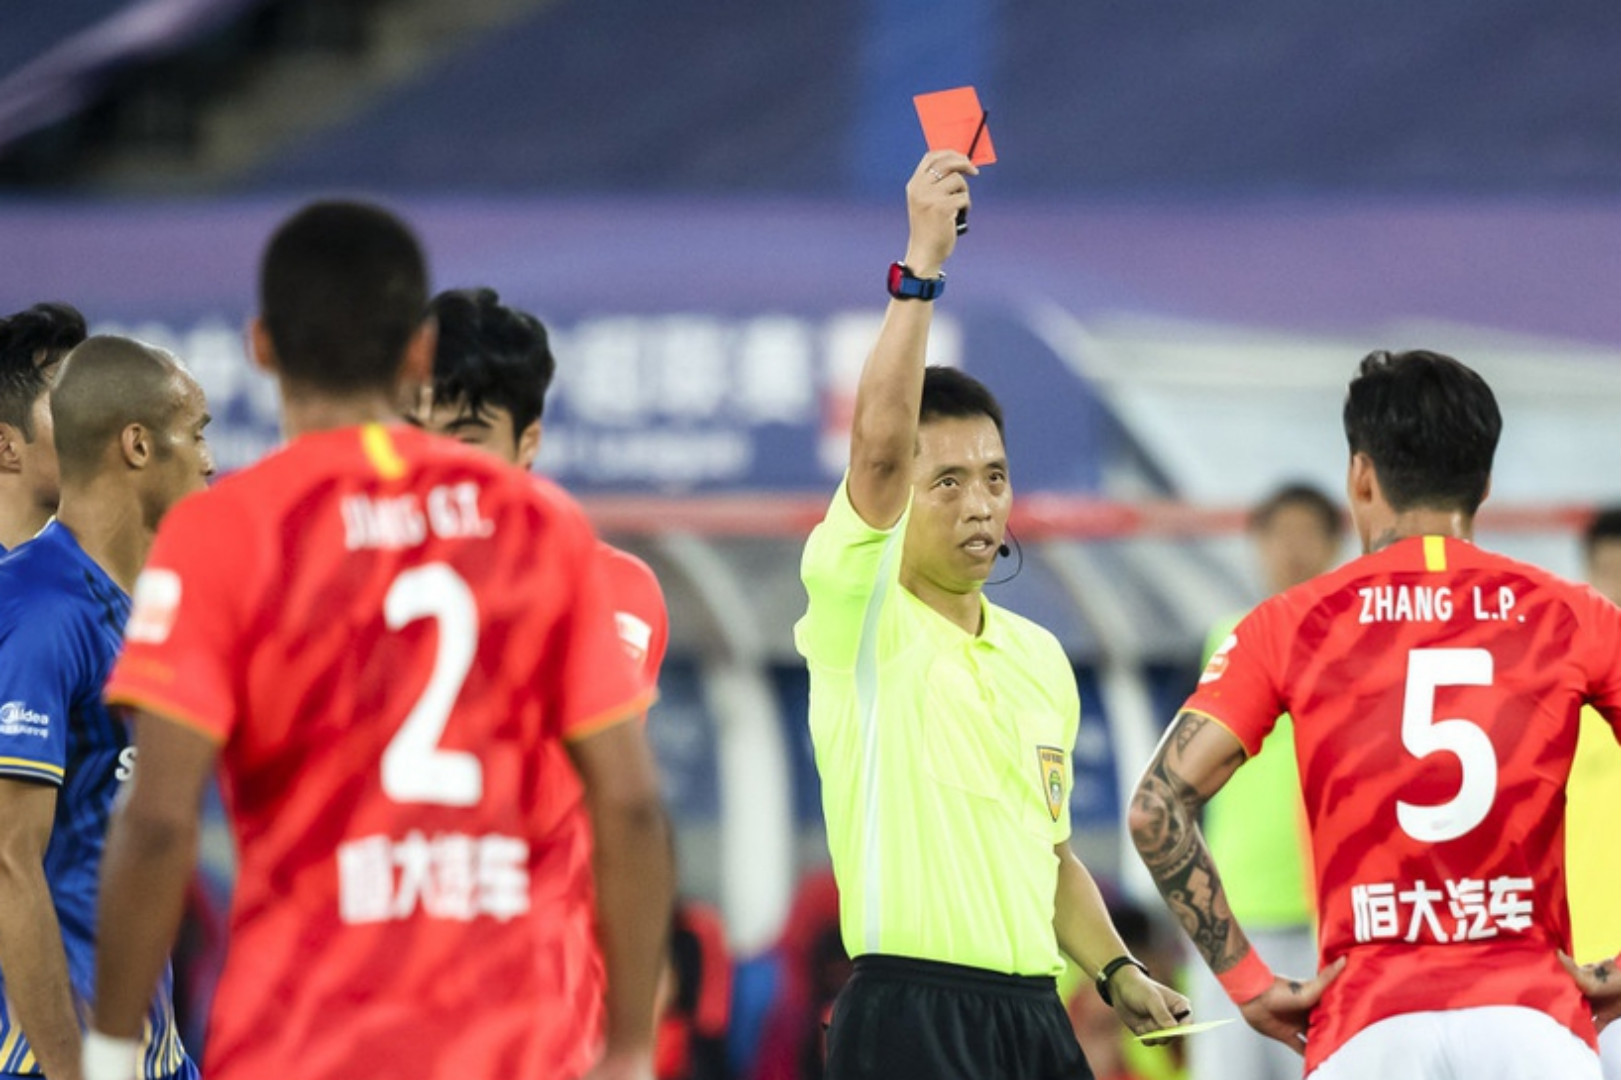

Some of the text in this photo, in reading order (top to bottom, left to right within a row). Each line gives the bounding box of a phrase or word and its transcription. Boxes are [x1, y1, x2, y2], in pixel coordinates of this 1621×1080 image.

[1358, 584, 1526, 625] ZHANG L.P.
[380, 561, 483, 807] 2
[1396, 647, 1498, 843] 5
[1351, 876, 1534, 943] 恒大汽车
